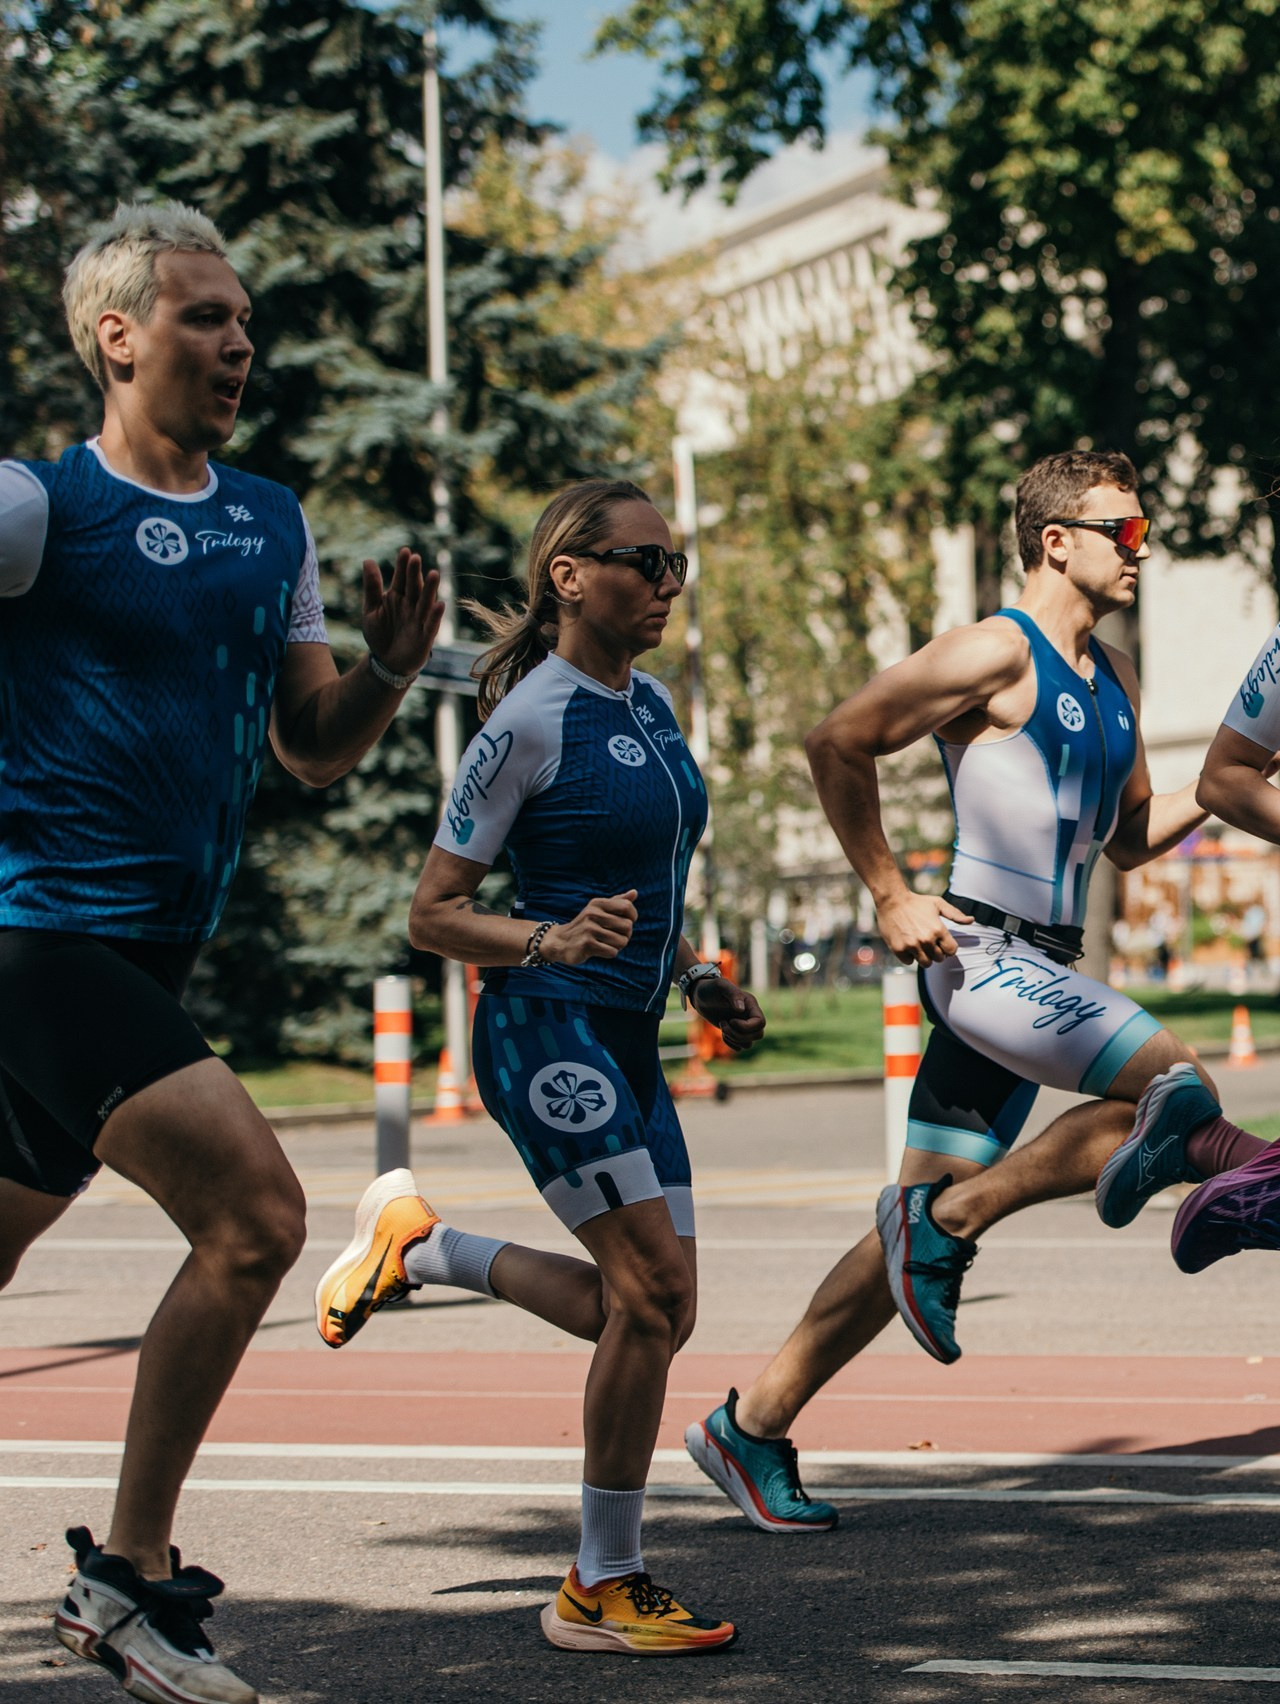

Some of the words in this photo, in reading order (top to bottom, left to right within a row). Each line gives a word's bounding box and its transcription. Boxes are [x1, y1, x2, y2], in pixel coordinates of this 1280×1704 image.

[195, 530, 265, 556] Trilogy
[448, 730, 513, 837] Trilogy
[970, 956, 1107, 1036] Trilogy
[908, 1188, 925, 1224] HOKA
